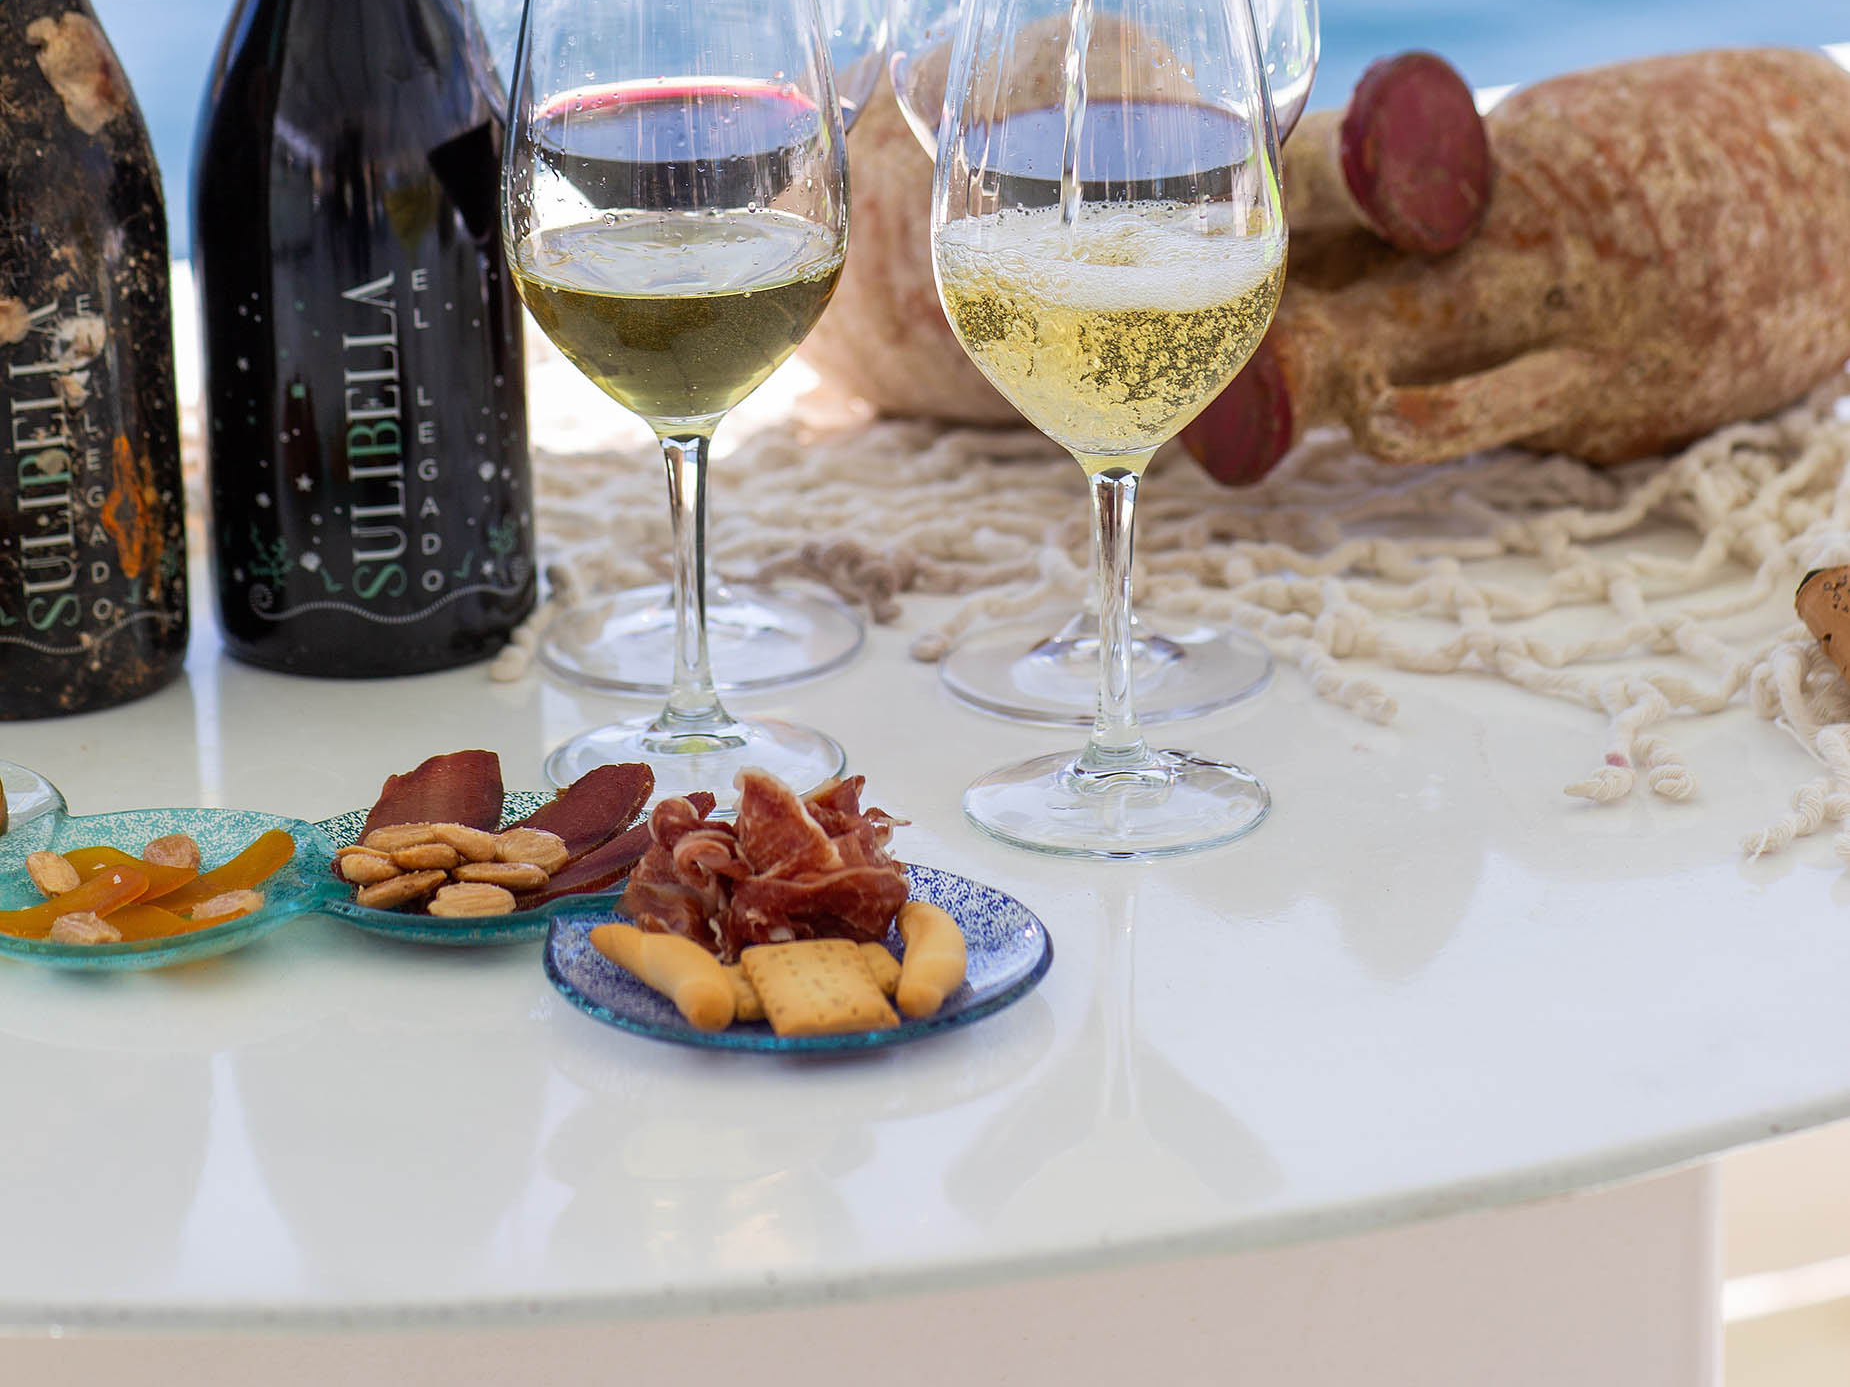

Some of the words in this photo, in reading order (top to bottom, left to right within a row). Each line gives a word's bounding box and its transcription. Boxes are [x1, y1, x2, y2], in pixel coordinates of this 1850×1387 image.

[411, 268, 429, 329] EL
[83, 413, 115, 621] LEGADO
[341, 271, 407, 599] SULIBELLA
[417, 386, 445, 592] LEGADO
